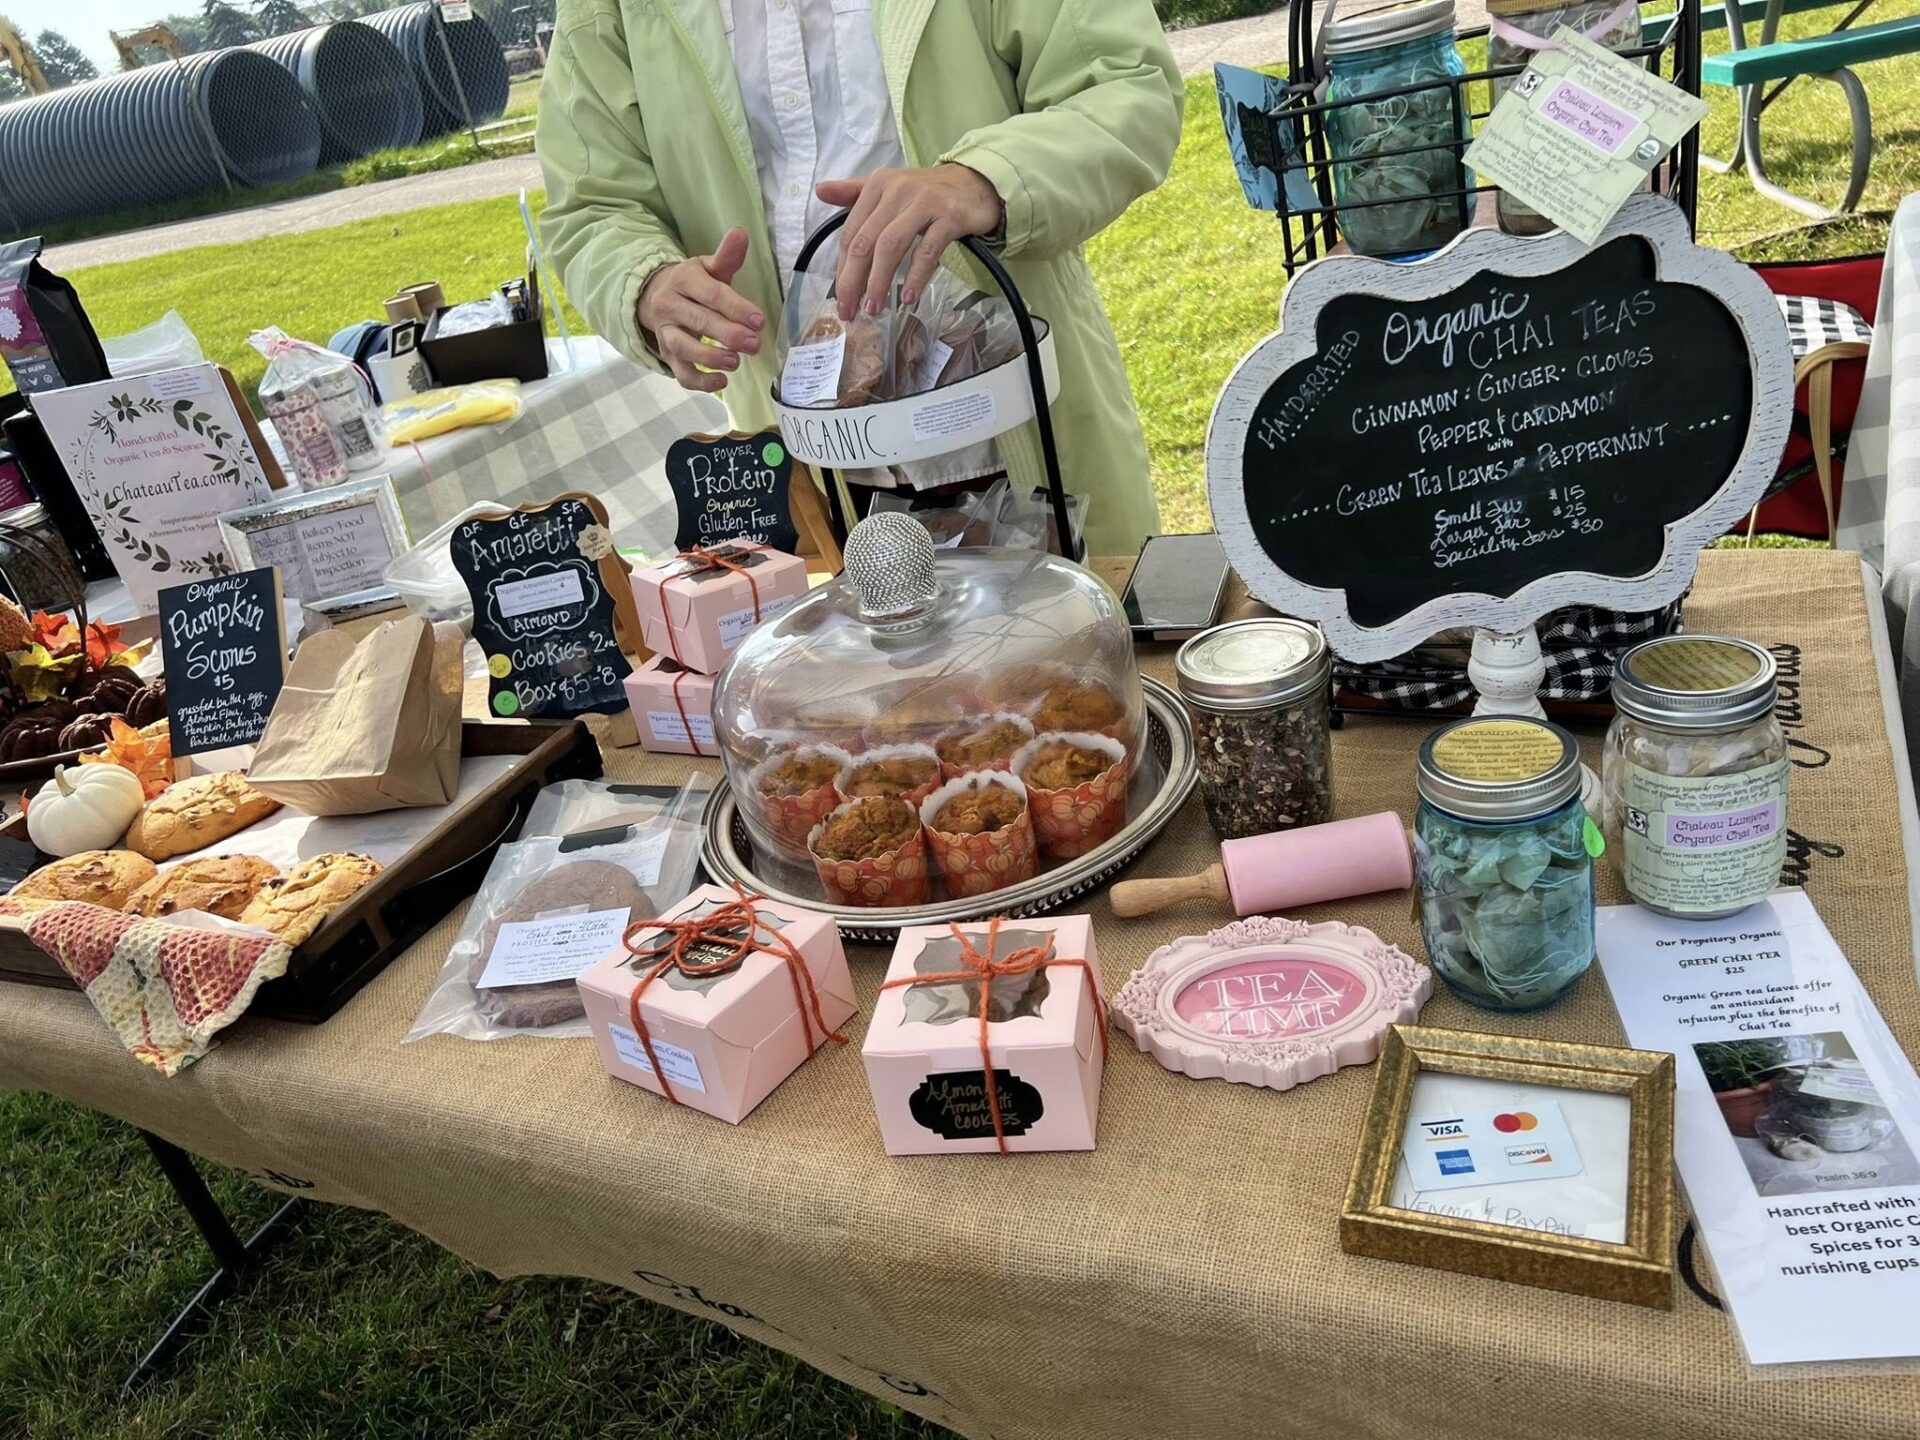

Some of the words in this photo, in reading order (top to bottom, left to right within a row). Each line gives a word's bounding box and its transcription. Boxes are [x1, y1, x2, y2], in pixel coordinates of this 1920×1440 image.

[1383, 287, 1530, 368] Organic
[1468, 314, 1553, 369] CHAI
[1572, 289, 1656, 341] TEAS
[115, 429, 180, 450] Handcrafted
[1487, 437, 1514, 452] with
[103, 451, 142, 467] Organic
[143, 448, 161, 458] Tea
[171, 442, 206, 454] Scones
[713, 444, 755, 462] POWER
[112, 470, 231, 503] ChateauTea.com
[706, 494, 757, 518] Organic
[1434, 501, 1482, 529] Small
[470, 515, 576, 571] Amaretti
[311, 551, 344, 566] subject
[315, 557, 366, 577] Inspection
[187, 577, 249, 602] Organic
[168, 591, 264, 648] Pumpkin
[718, 616, 743, 628] Organic
[186, 641, 257, 679] Scones
[512, 639, 587, 671] Cookies
[214, 674, 235, 690] $5
[514, 680, 557, 711] Box
[1672, 833, 1722, 848] Organic
[1726, 828, 1750, 841] Chai
[1752, 822, 1770, 835] Tea
[1675, 819, 1724, 832] Chateau
[1655, 939, 1677, 947] Our
[1739, 929, 1783, 942] Organic
[1678, 955, 1719, 969] GREEN
[1722, 952, 1753, 964] CHAI
[1756, 950, 1781, 960] TEA
[1724, 966, 1745, 975] $25
[1197, 968, 1345, 1010] TEA
[1662, 991, 1707, 1004] Organic
[1710, 989, 1742, 1000] Green
[1745, 987, 1763, 996] tea
[1765, 981, 1800, 994] leaves
[1803, 979, 1833, 993] offer
[1710, 1002, 1725, 1011] an
[1728, 995, 1796, 1010] antioxidant
[1678, 1013, 1727, 1027] infusion
[1727, 1009, 1754, 1024] plus
[1757, 1007, 1776, 1018] the
[1779, 1004, 1825, 1018] benefits
[1828, 1002, 1842, 1016] of
[1738, 1021, 1766, 1033] Chai
[1768, 1019, 1792, 1030] Tea
[926, 1080, 1002, 1104] Almon
[1427, 1124, 1463, 1136] VISA
[1507, 1148, 1547, 1158] DISCOVER
[1814, 1173, 1851, 1183] Psalm
[1852, 1170, 1878, 1180] 36:9
[1766, 1199, 1871, 1219] Hancrafted
[1874, 1196, 1916, 1210] with
[1785, 1223, 1829, 1236] best
[1830, 1217, 1905, 1234] Organic
[1809, 1240, 1873, 1257] Spices
[1875, 1237, 1904, 1250] for
[1780, 1260, 1872, 1276] nurishing
[1873, 1257, 1920, 1272] cups
